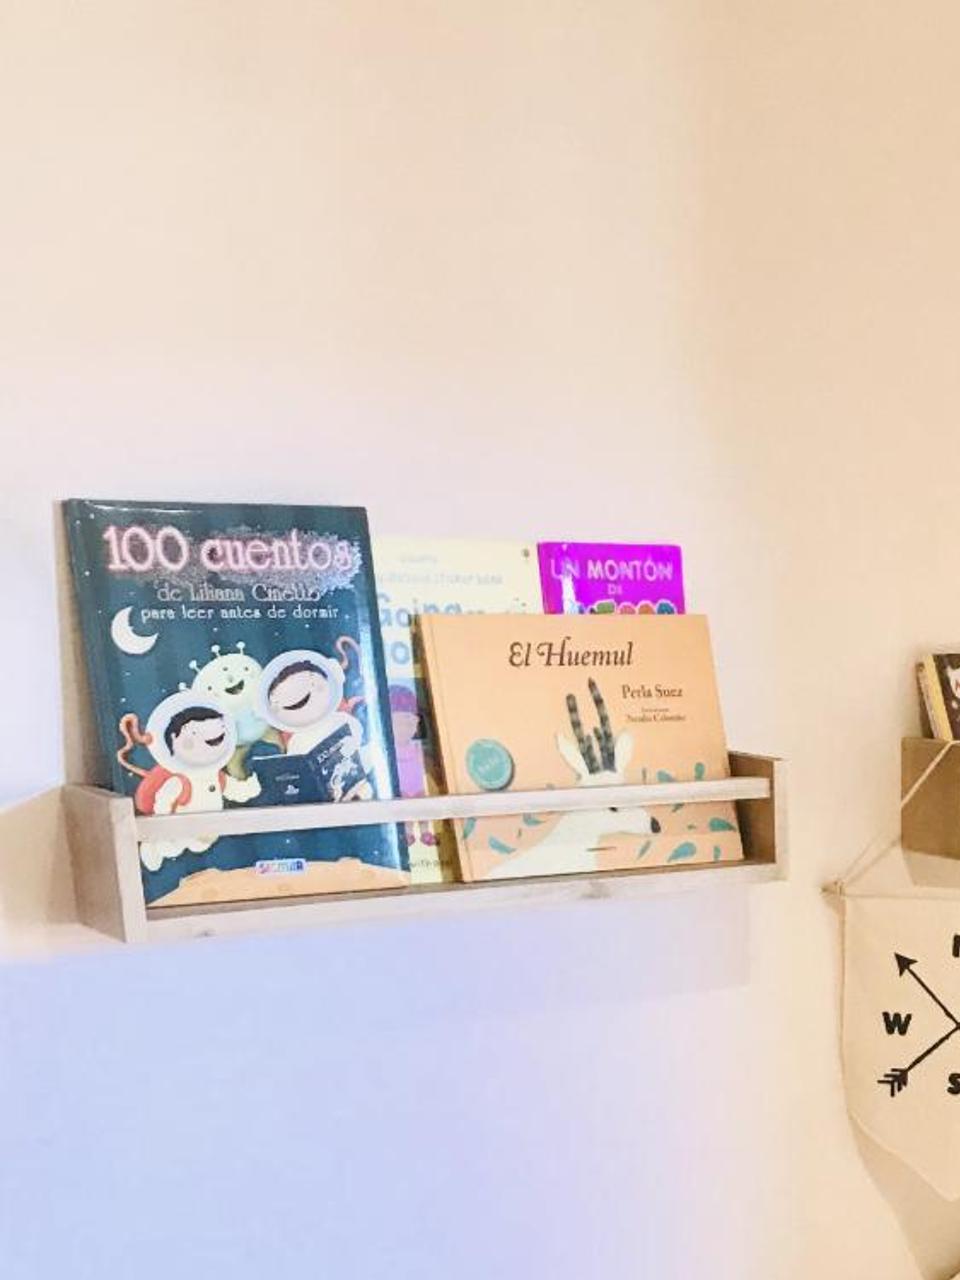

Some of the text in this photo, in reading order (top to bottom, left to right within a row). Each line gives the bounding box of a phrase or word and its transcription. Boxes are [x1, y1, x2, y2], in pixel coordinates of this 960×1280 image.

[103, 526, 353, 571] 100 cuentos
[587, 555, 674, 581] MONTÓN
[140, 603, 340, 624] para leer antes de dormir
[508, 635, 635, 668] El Huemul
[621, 683, 653, 700] Perla
[882, 1011, 912, 1036] W
